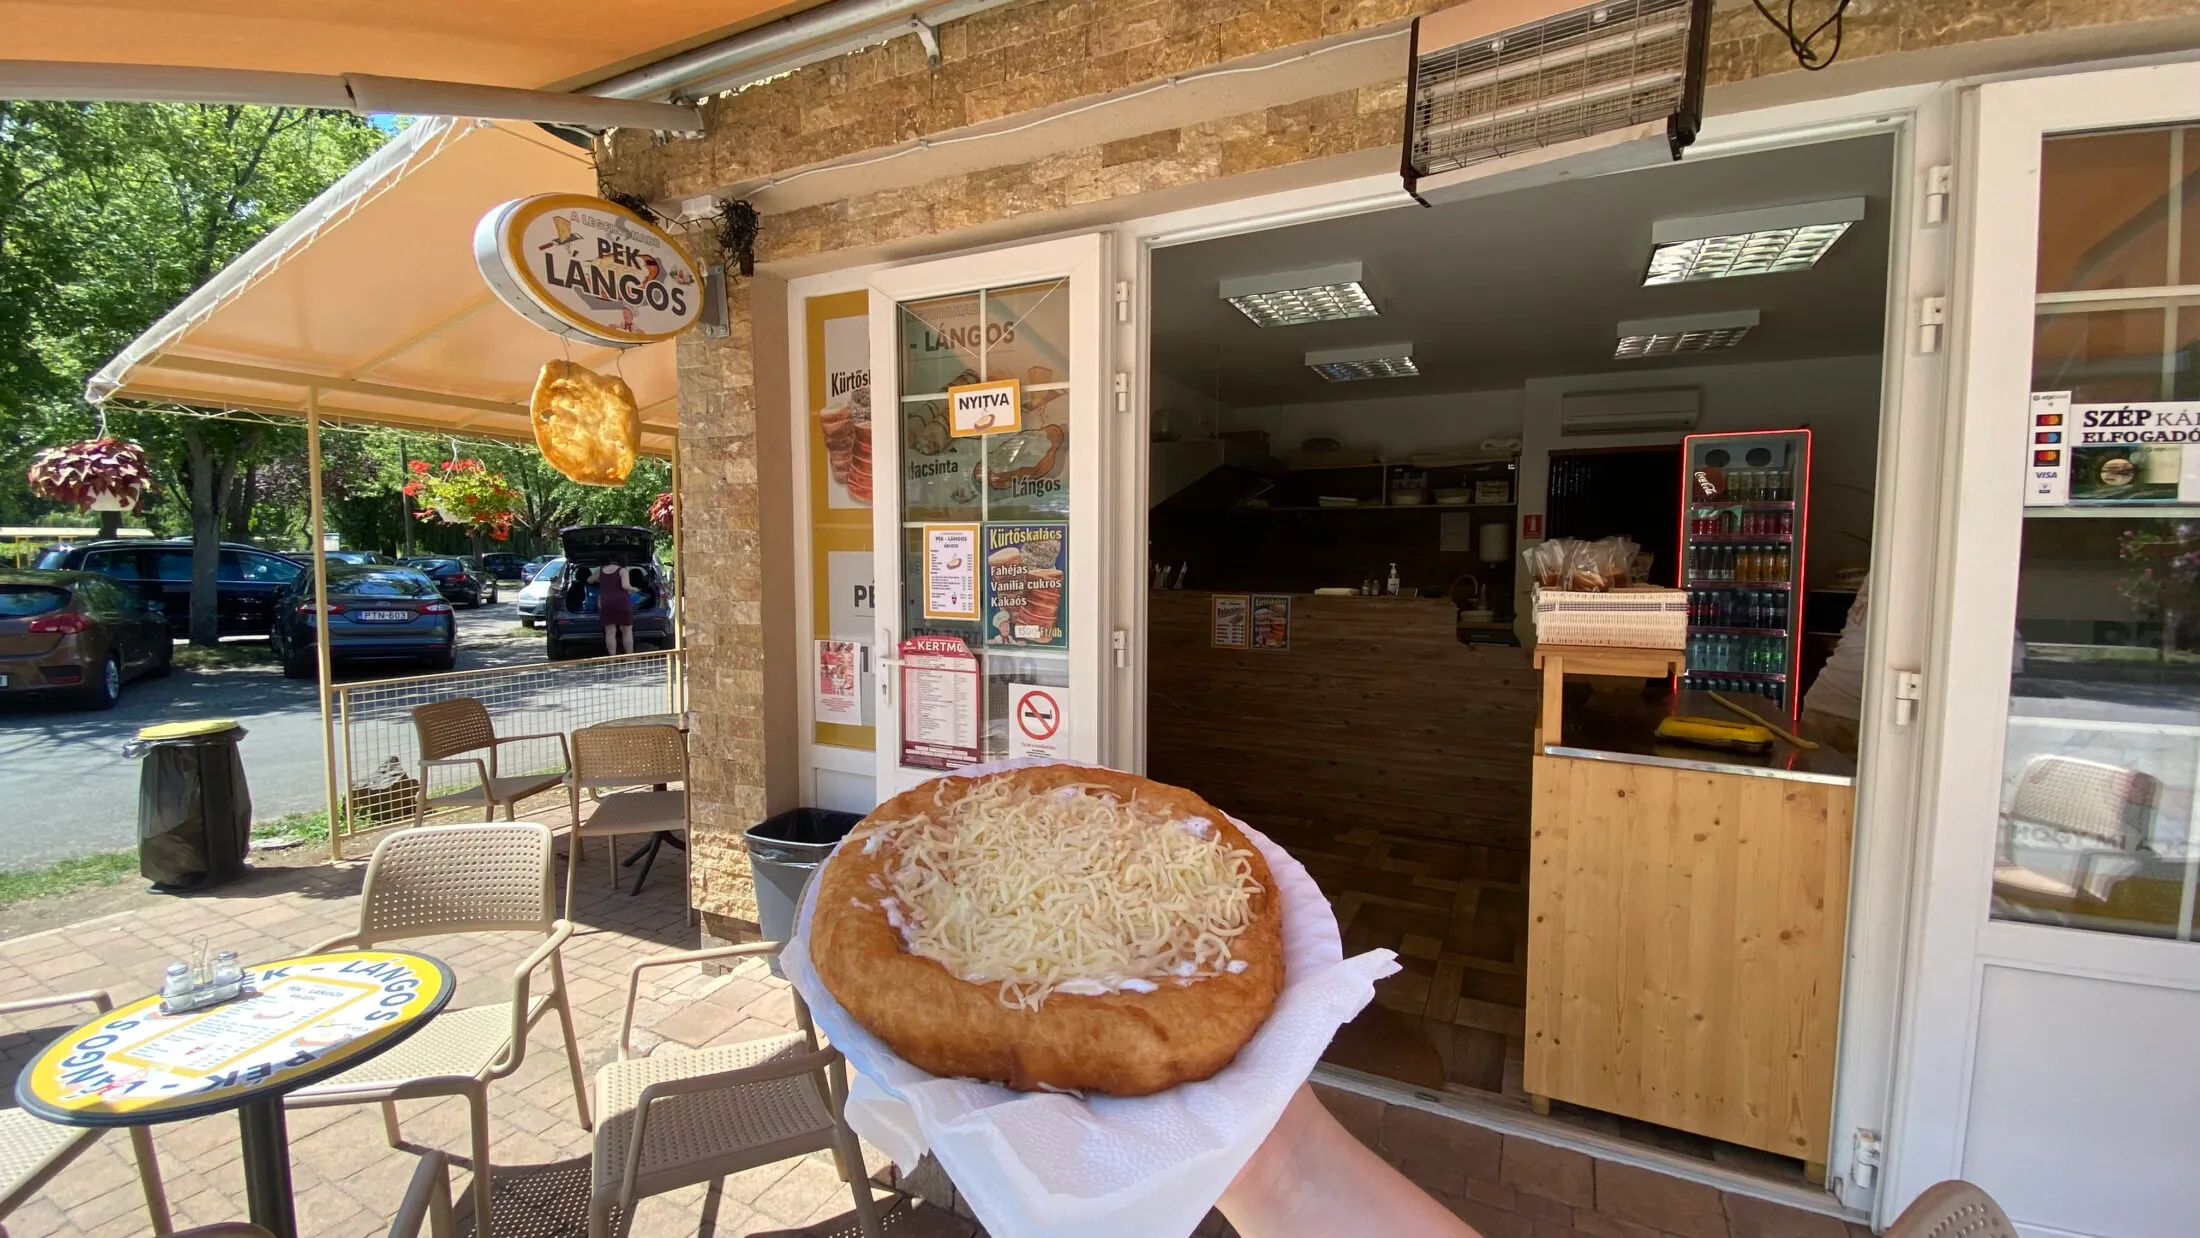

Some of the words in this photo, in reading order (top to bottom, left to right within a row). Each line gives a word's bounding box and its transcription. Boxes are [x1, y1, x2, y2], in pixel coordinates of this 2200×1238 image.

[597, 237, 643, 271] PÉK
[544, 250, 687, 316] LÁNGOS
[925, 321, 1015, 352] LÁNGOS
[958, 392, 1010, 411] NYITVA
[2082, 405, 2152, 428] SZÉP
[908, 459, 958, 481] lacsinta
[1012, 476, 1061, 499] Lángos
[990, 528, 1063, 550] Kürtőskalács
[991, 564, 1028, 577] Fahéjas
[1027, 578, 1062, 590] cukros
[991, 595, 1027, 607] Kakaós
[364, 612, 407, 620] PTN-603
[1040, 626, 1063, 639] Ft/db
